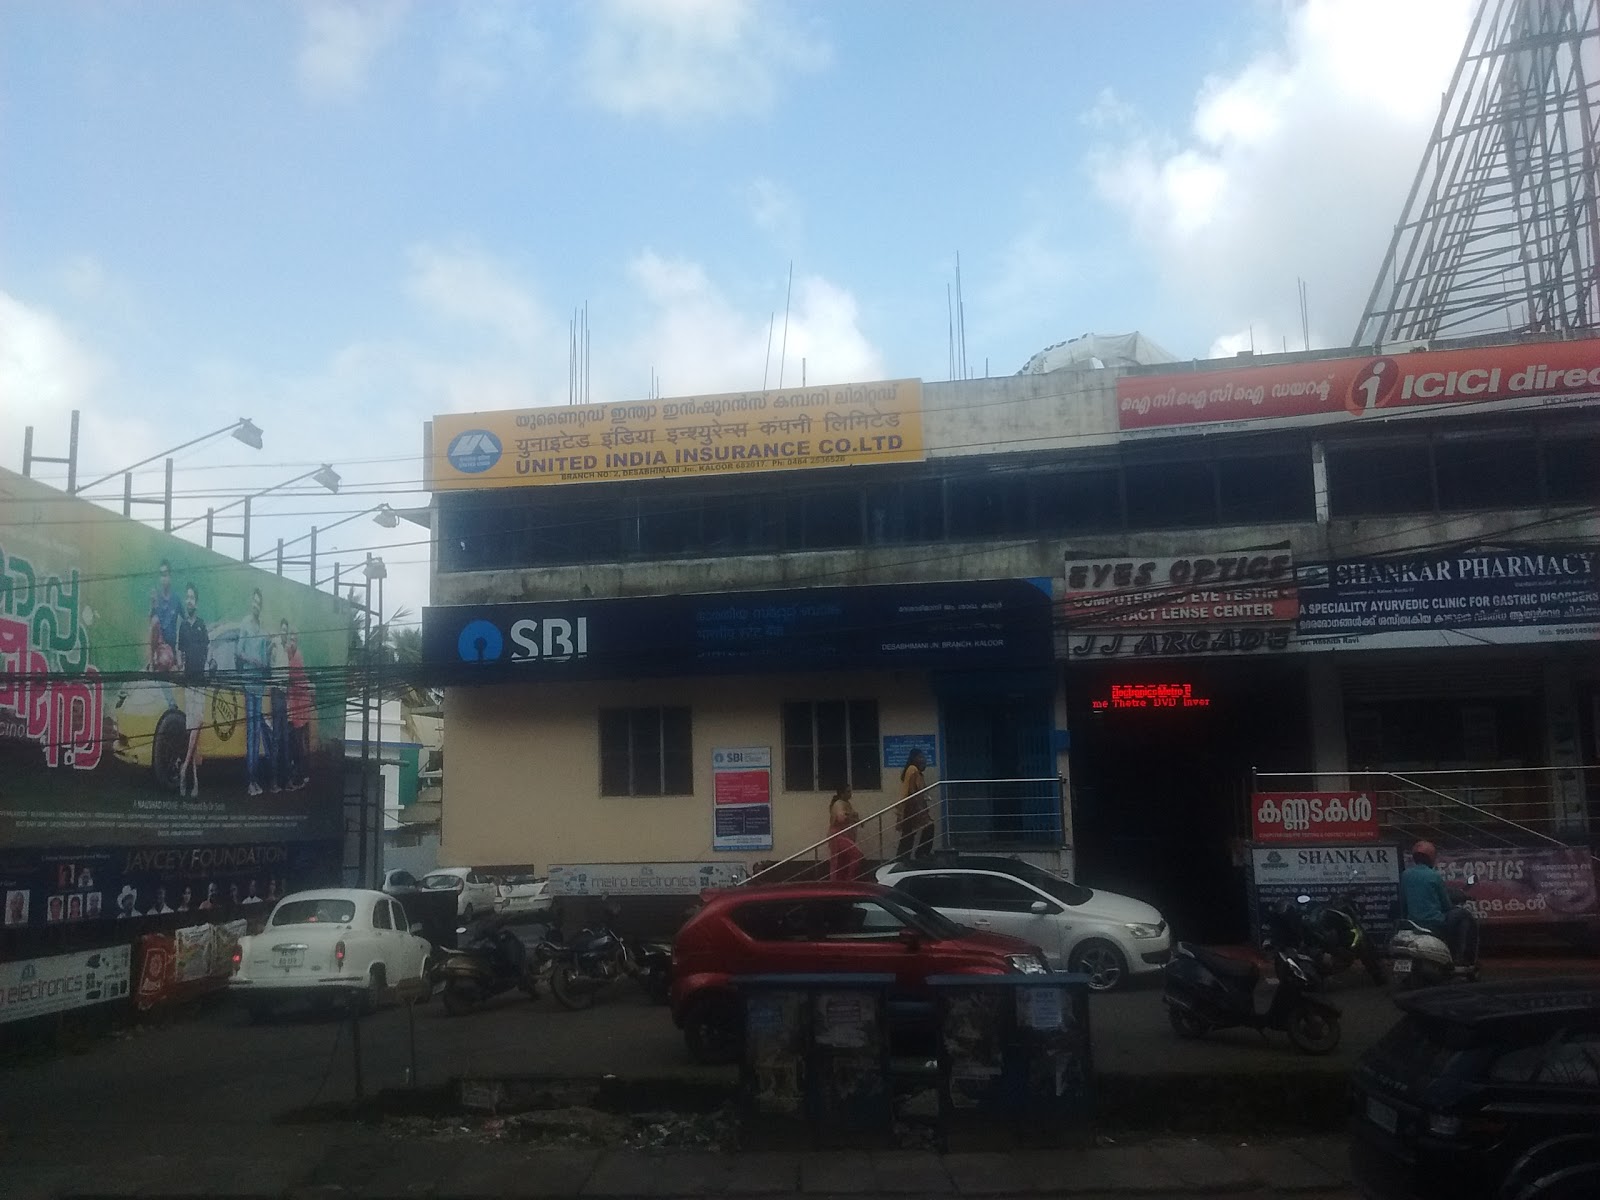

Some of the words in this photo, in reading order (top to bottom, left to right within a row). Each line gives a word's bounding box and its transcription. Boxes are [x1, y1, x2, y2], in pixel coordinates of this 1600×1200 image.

[1401, 368, 1501, 400] ICICI
[601, 427, 657, 449] इंडिया
[824, 408, 902, 432] लिमिटेड
[516, 456, 598, 475] UNITED
[605, 450, 668, 468] INDIA
[675, 440, 810, 465] INSURANCE
[818, 434, 903, 455] CO.LTD
[561, 472, 595, 480] BRANCH
[622, 465, 680, 477] DESABHIMANI
[699, 462, 734, 473] KALOOR
[1069, 561, 1156, 589] EYES
[1336, 560, 1452, 586] SHANKAR
[1457, 552, 1596, 580] PHARMACY
[1190, 588, 1220, 603] EYE
[1300, 604, 1307, 615] A
[1308, 601, 1367, 614] SPECIALITY
[1370, 598, 1429, 612] AYURVEDIC
[1432, 596, 1467, 609] CLINIC
[1469, 595, 1491, 607] FOR
[1492, 593, 1538, 606] GASTRIC
[1161, 605, 1209, 620] LENSE
[1213, 603, 1275, 617] CENTER
[509, 616, 588, 663] SBI
[975, 639, 1004, 647] KALOOR
[1134, 626, 1291, 655] ARCADE
[1092, 700, 1109, 708] me
[1153, 698, 1177, 706] DVD
[1183, 697, 1210, 706] Inver
[726, 752, 743, 763] SBI
[1257, 793, 1372, 830] കണ്ണടകൾ
[123, 850, 187, 874] JAYCEY
[191, 847, 288, 867] FOUNDATION
[1298, 850, 1388, 864] SHANKAR
[591, 876, 627, 888] metro
[630, 873, 697, 888] electronics
